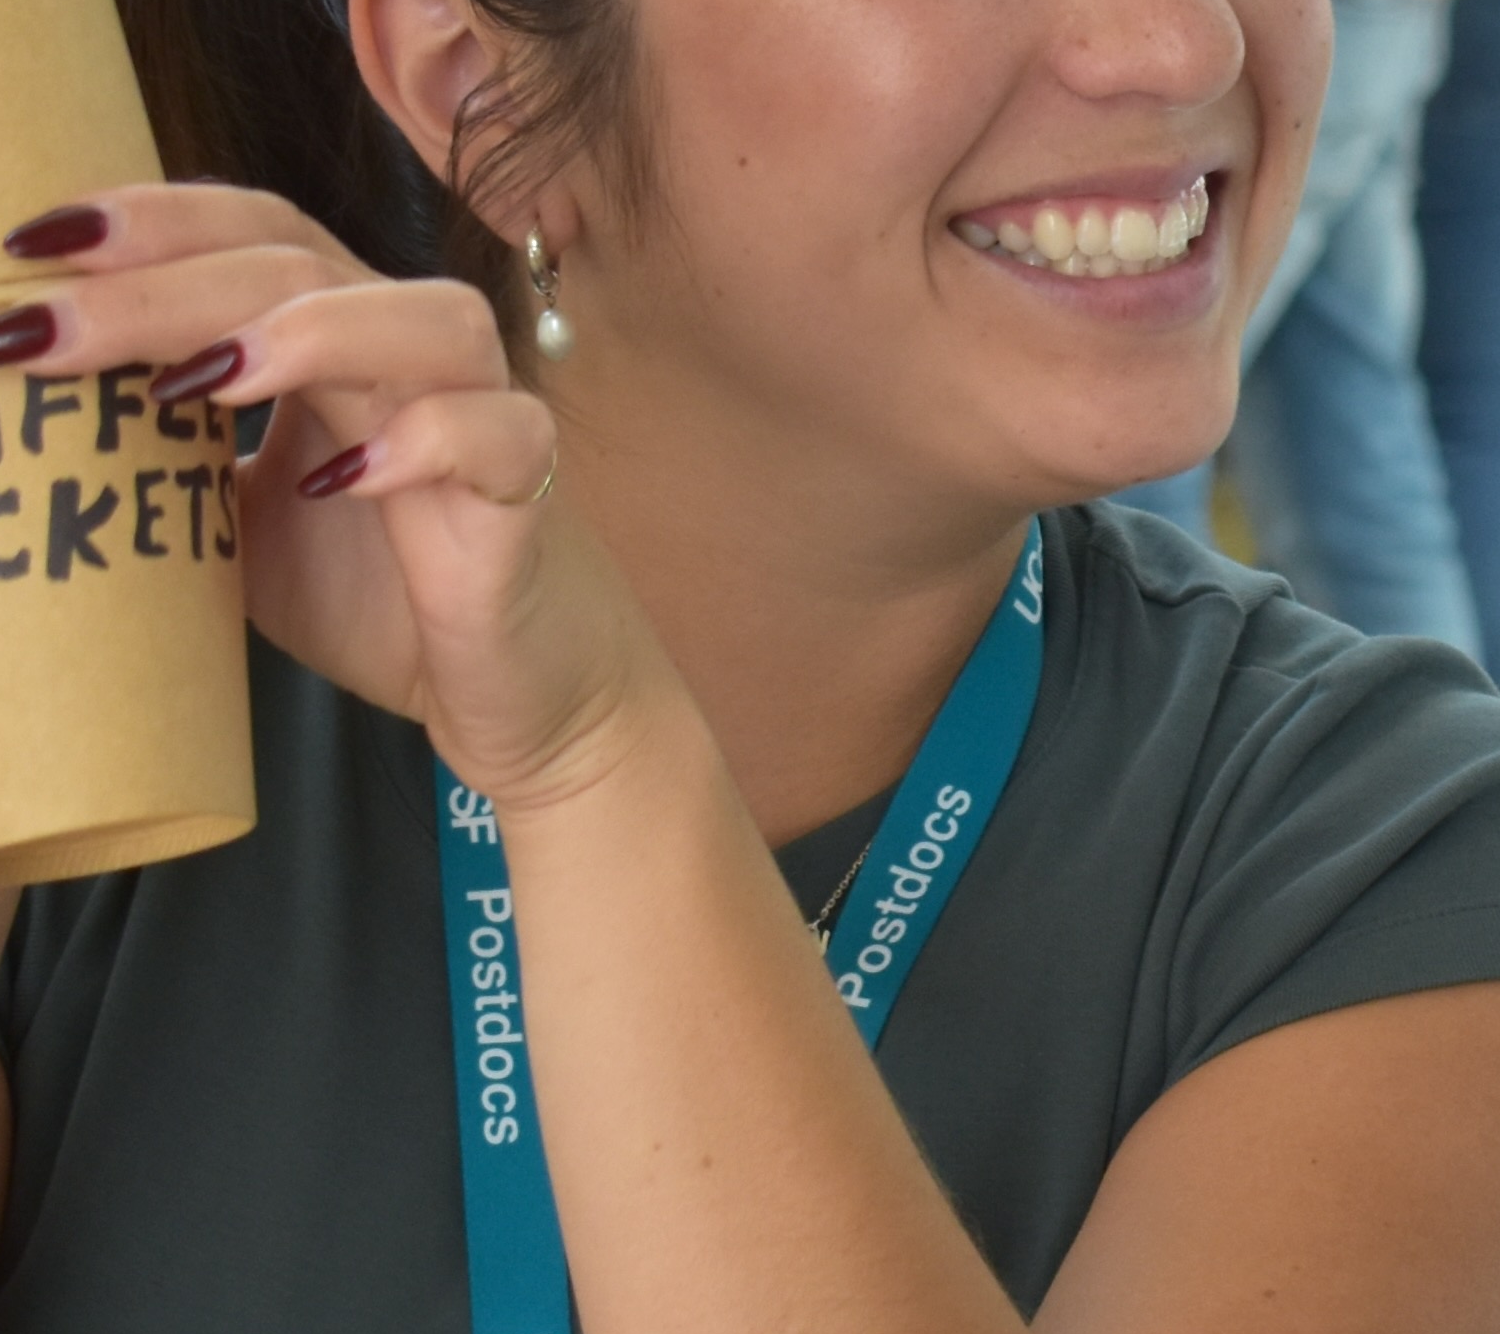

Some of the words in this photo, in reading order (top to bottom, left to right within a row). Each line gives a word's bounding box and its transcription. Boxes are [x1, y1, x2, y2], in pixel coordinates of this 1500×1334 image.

[449, 785, 498, 844] SF
[836, 783, 972, 1009] Postdocs
[467, 887, 523, 1146] Postdocs
